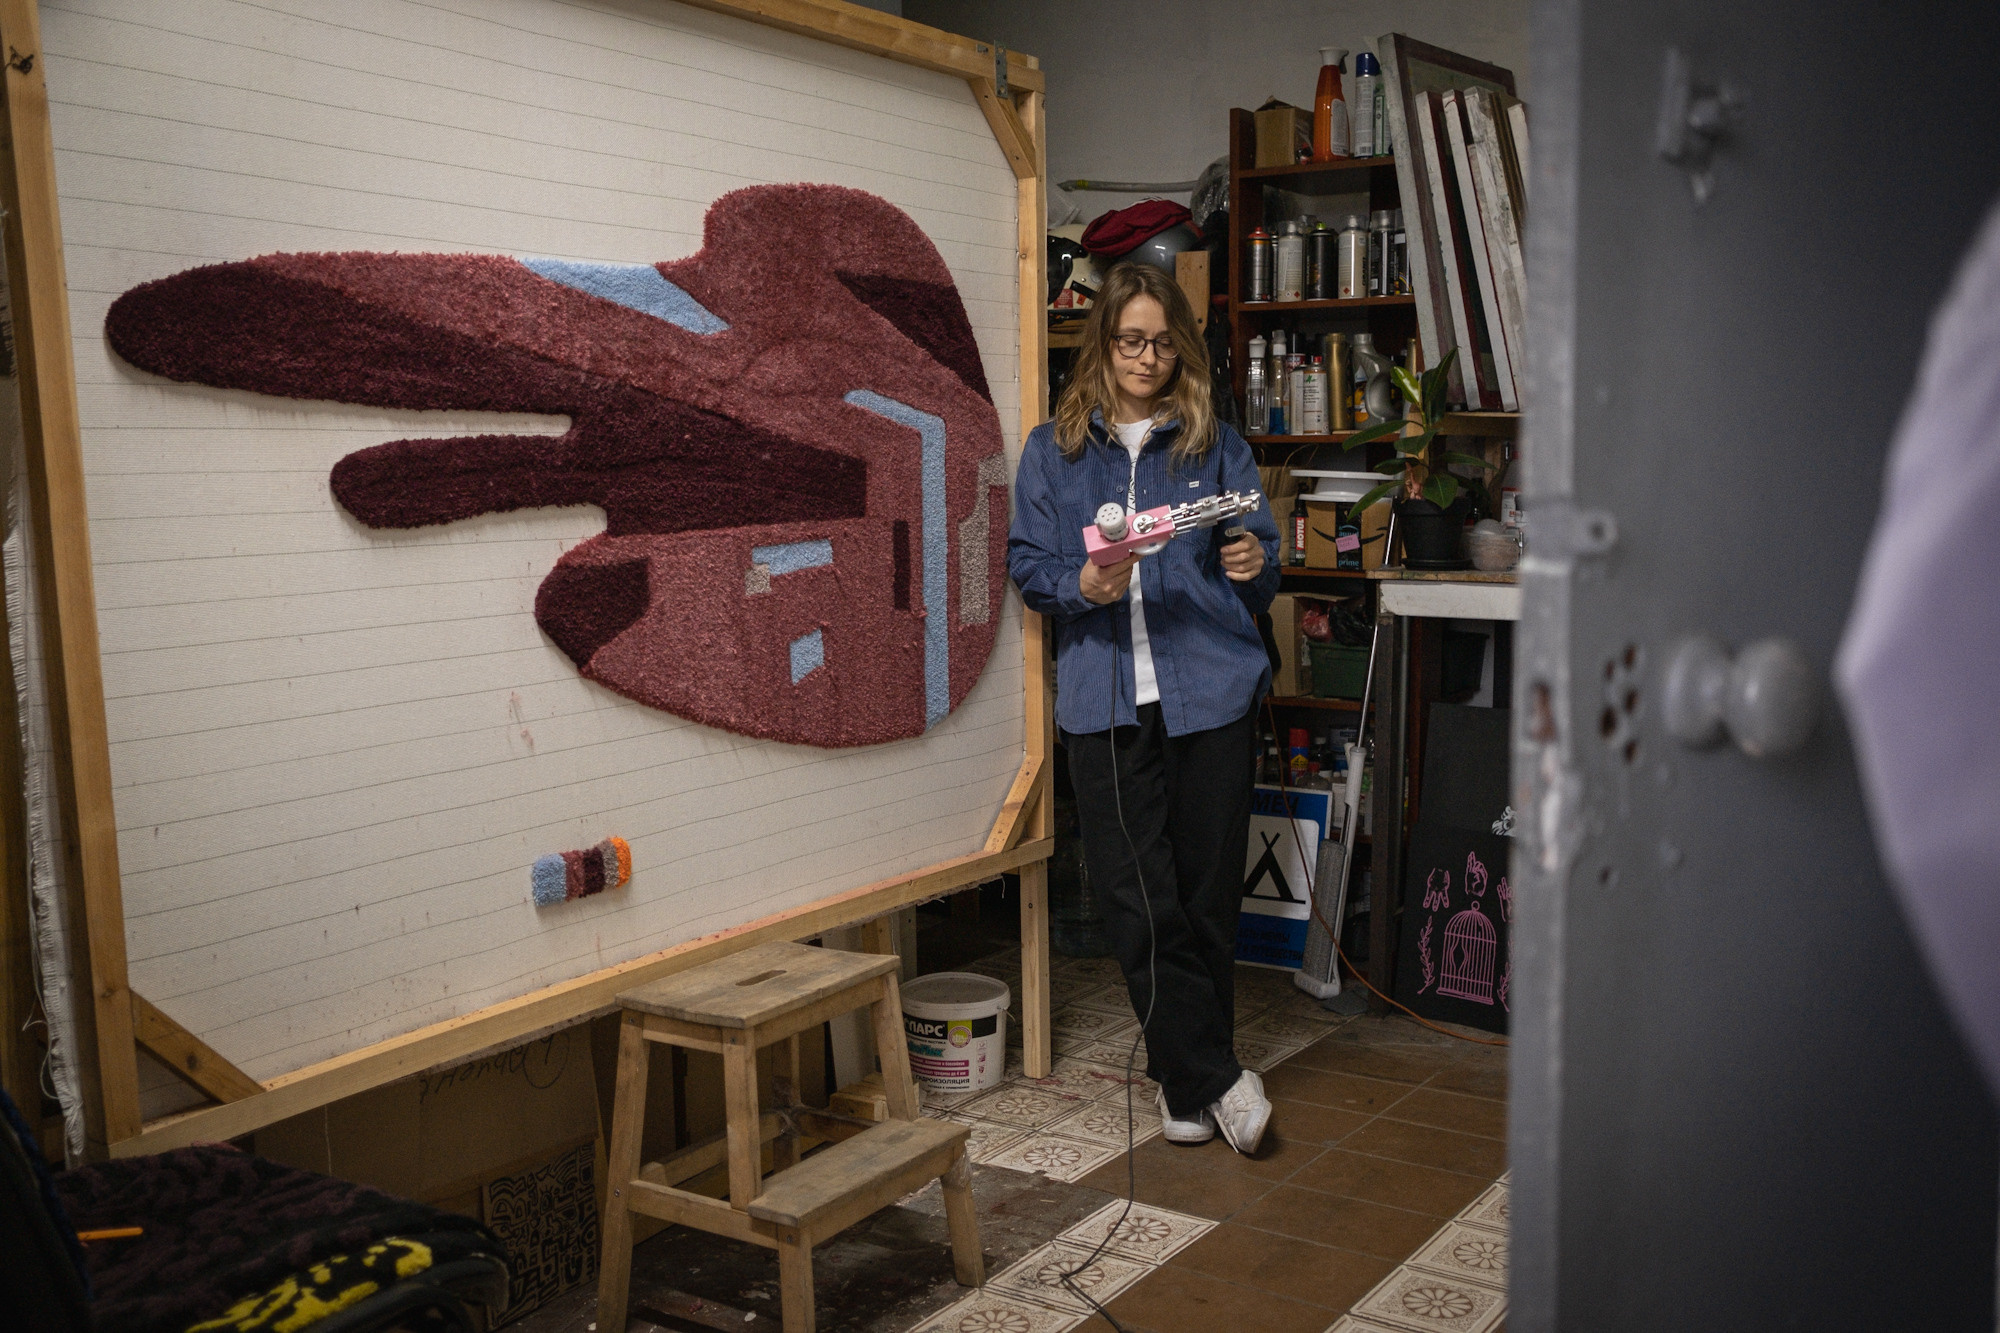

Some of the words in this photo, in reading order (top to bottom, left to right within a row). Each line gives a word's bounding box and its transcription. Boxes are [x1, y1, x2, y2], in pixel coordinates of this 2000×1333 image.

[1297, 518, 1305, 549] MOTUL
[1338, 559, 1360, 568] prime
[916, 1075, 970, 1085] ГИДРОИЗОЛЯЦИЯ
